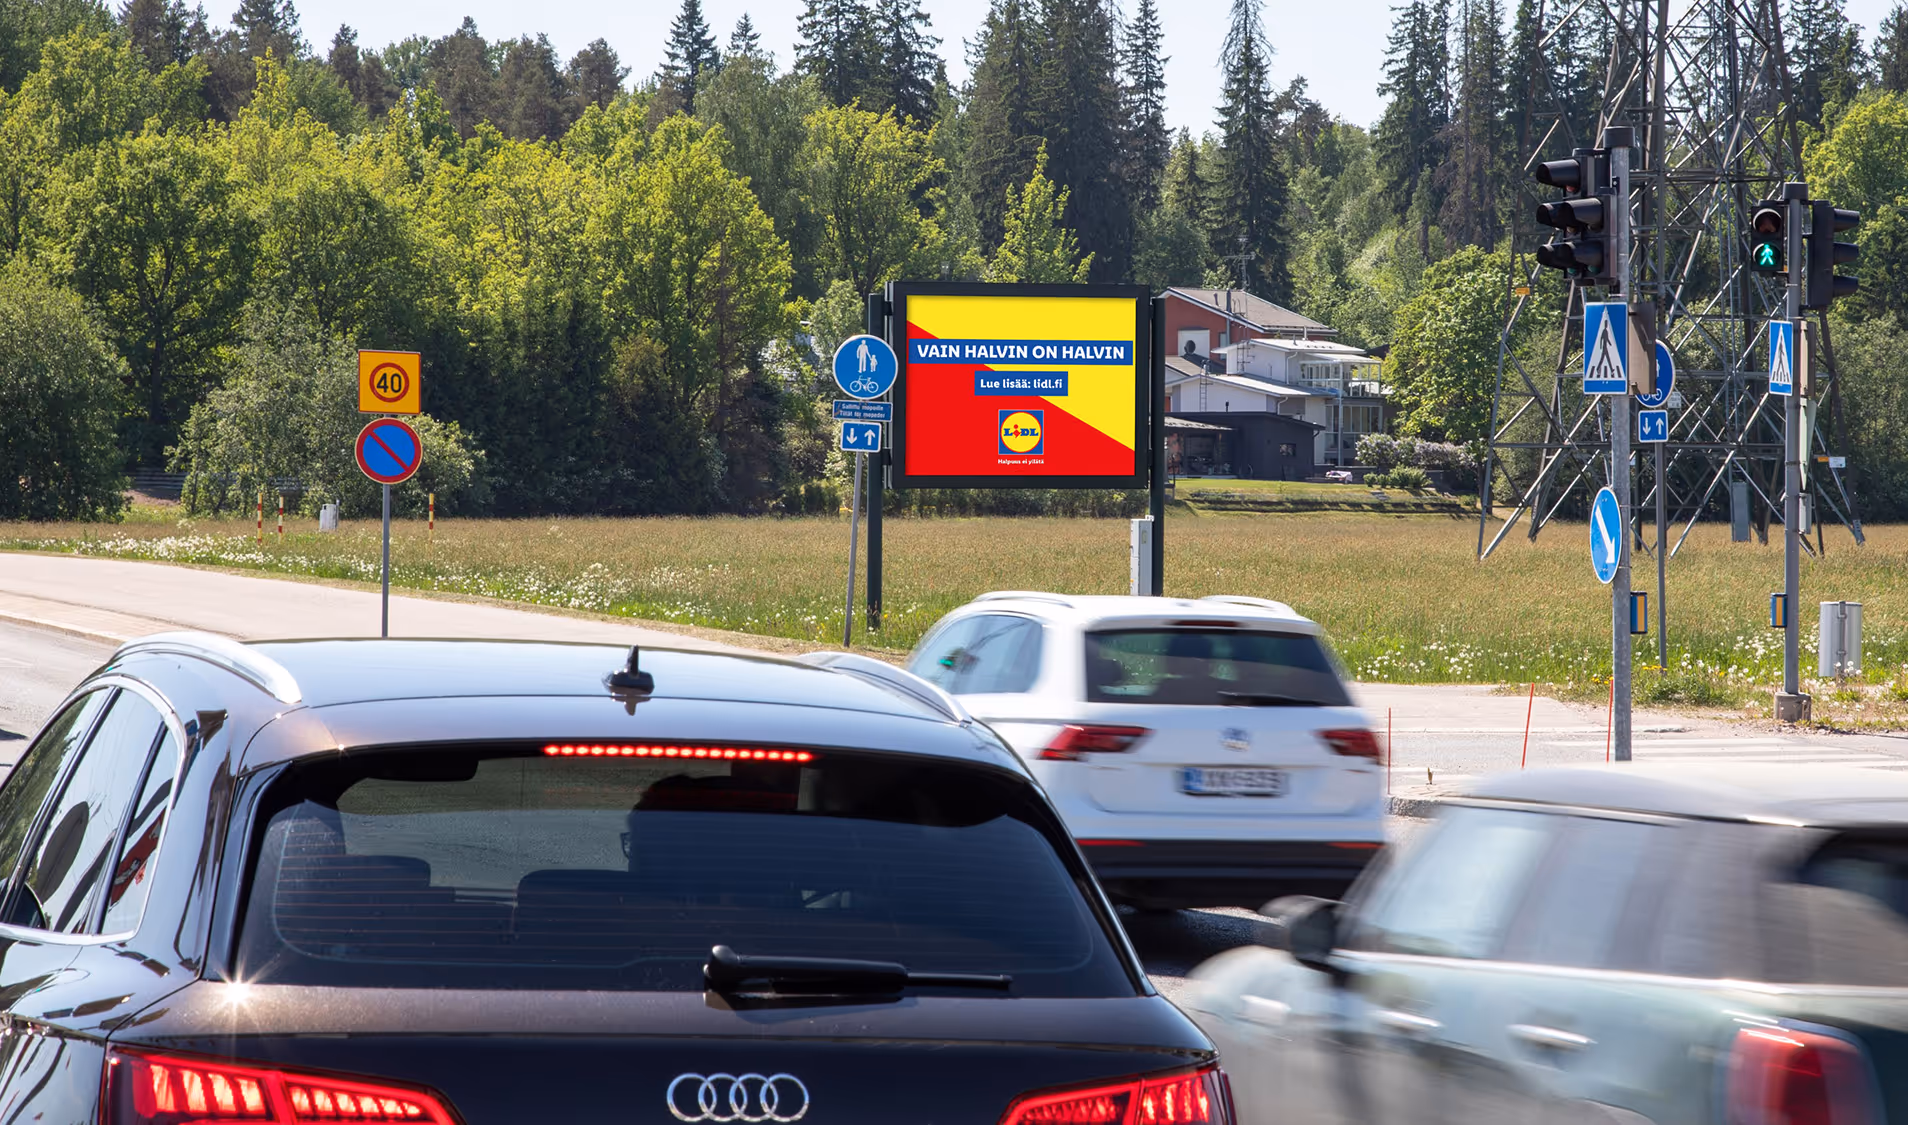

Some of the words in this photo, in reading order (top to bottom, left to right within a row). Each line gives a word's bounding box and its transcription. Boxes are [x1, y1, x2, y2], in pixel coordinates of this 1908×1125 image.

[917, 344, 960, 358] VAIN
[965, 345, 1028, 359] HALVIN
[1032, 345, 1057, 360] ON
[1062, 346, 1125, 360] HALVIN
[376, 372, 402, 393] 40
[980, 379, 1000, 388] Lue
[1002, 378, 1031, 389] lisää:
[1033, 379, 1062, 389] lidl.fi
